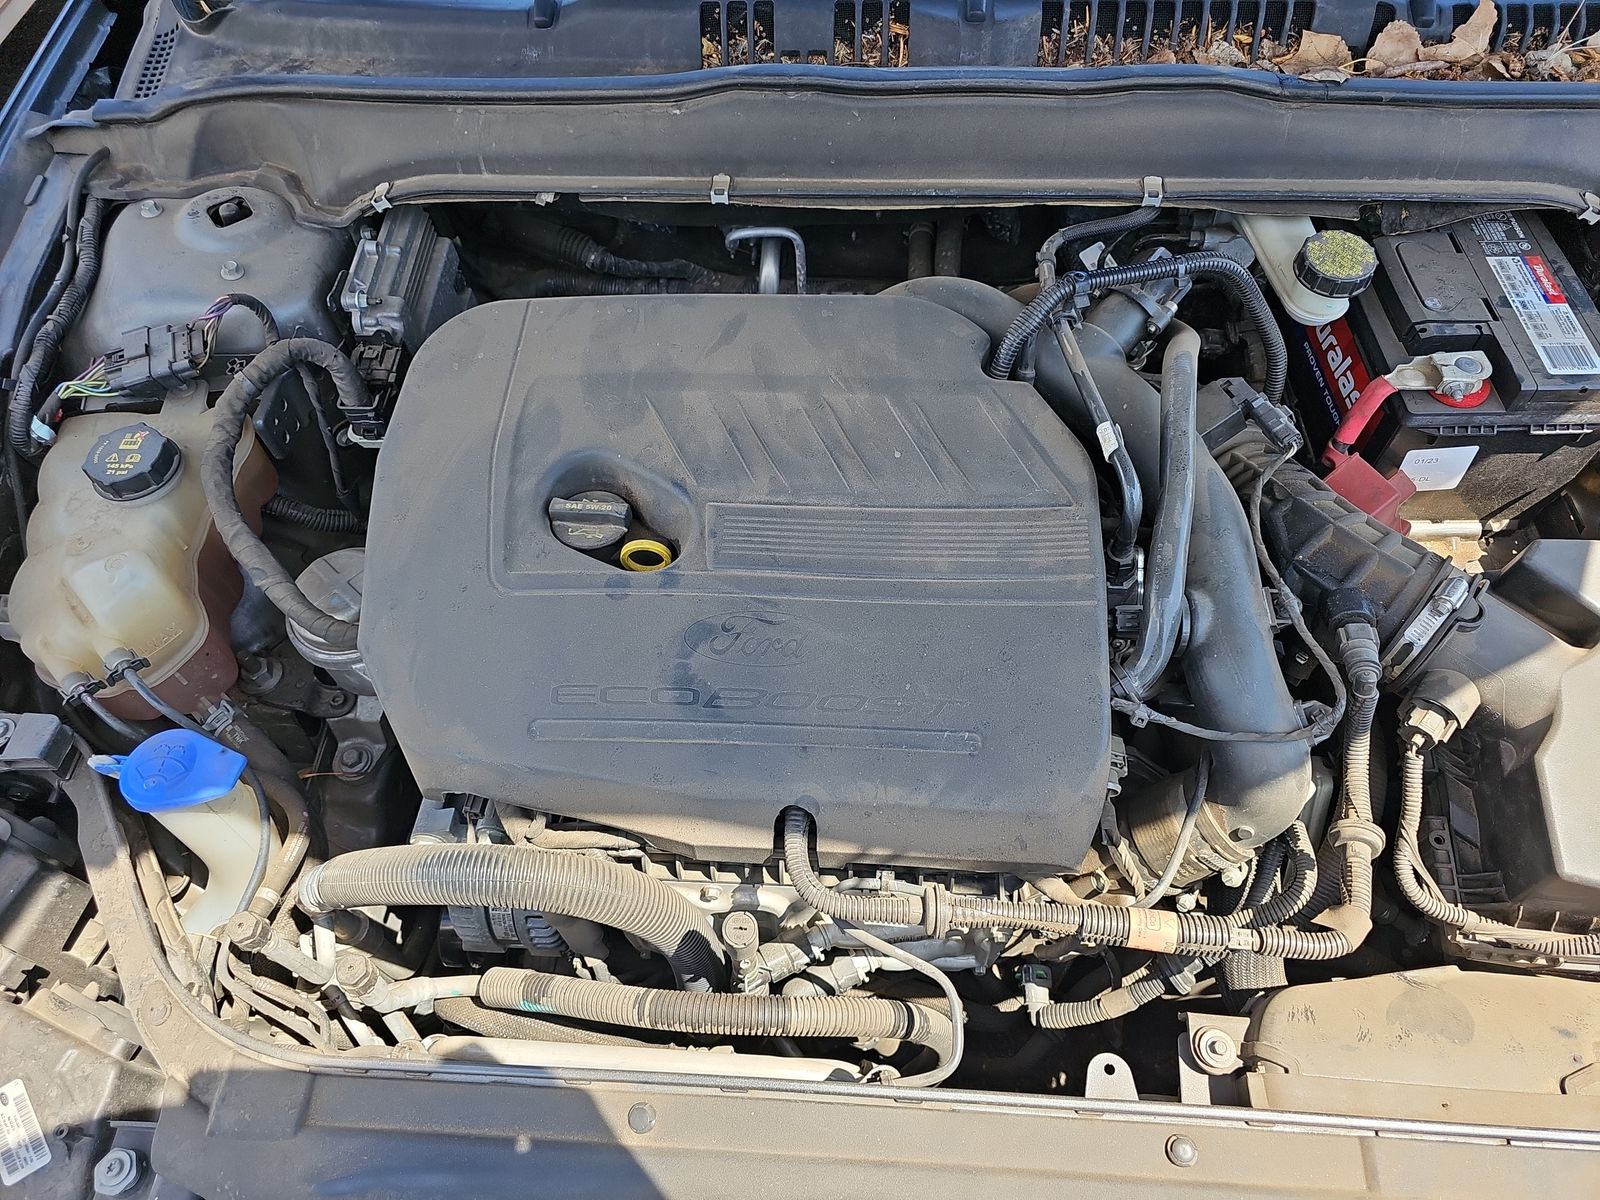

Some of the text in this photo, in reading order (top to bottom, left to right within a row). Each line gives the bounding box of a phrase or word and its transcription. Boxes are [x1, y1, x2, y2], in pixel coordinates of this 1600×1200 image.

[1508, 217, 1526, 238] POISON
[1534, 264, 1559, 296] Duralast
[1303, 341, 1325, 388] PROVEN
[1315, 324, 1361, 410] uralas
[1414, 457, 1440, 465] 01/23
[585, 503, 612, 511] 5W-20
[708, 614, 810, 659] Ford
[550, 683, 966, 718] ECOBOOST
